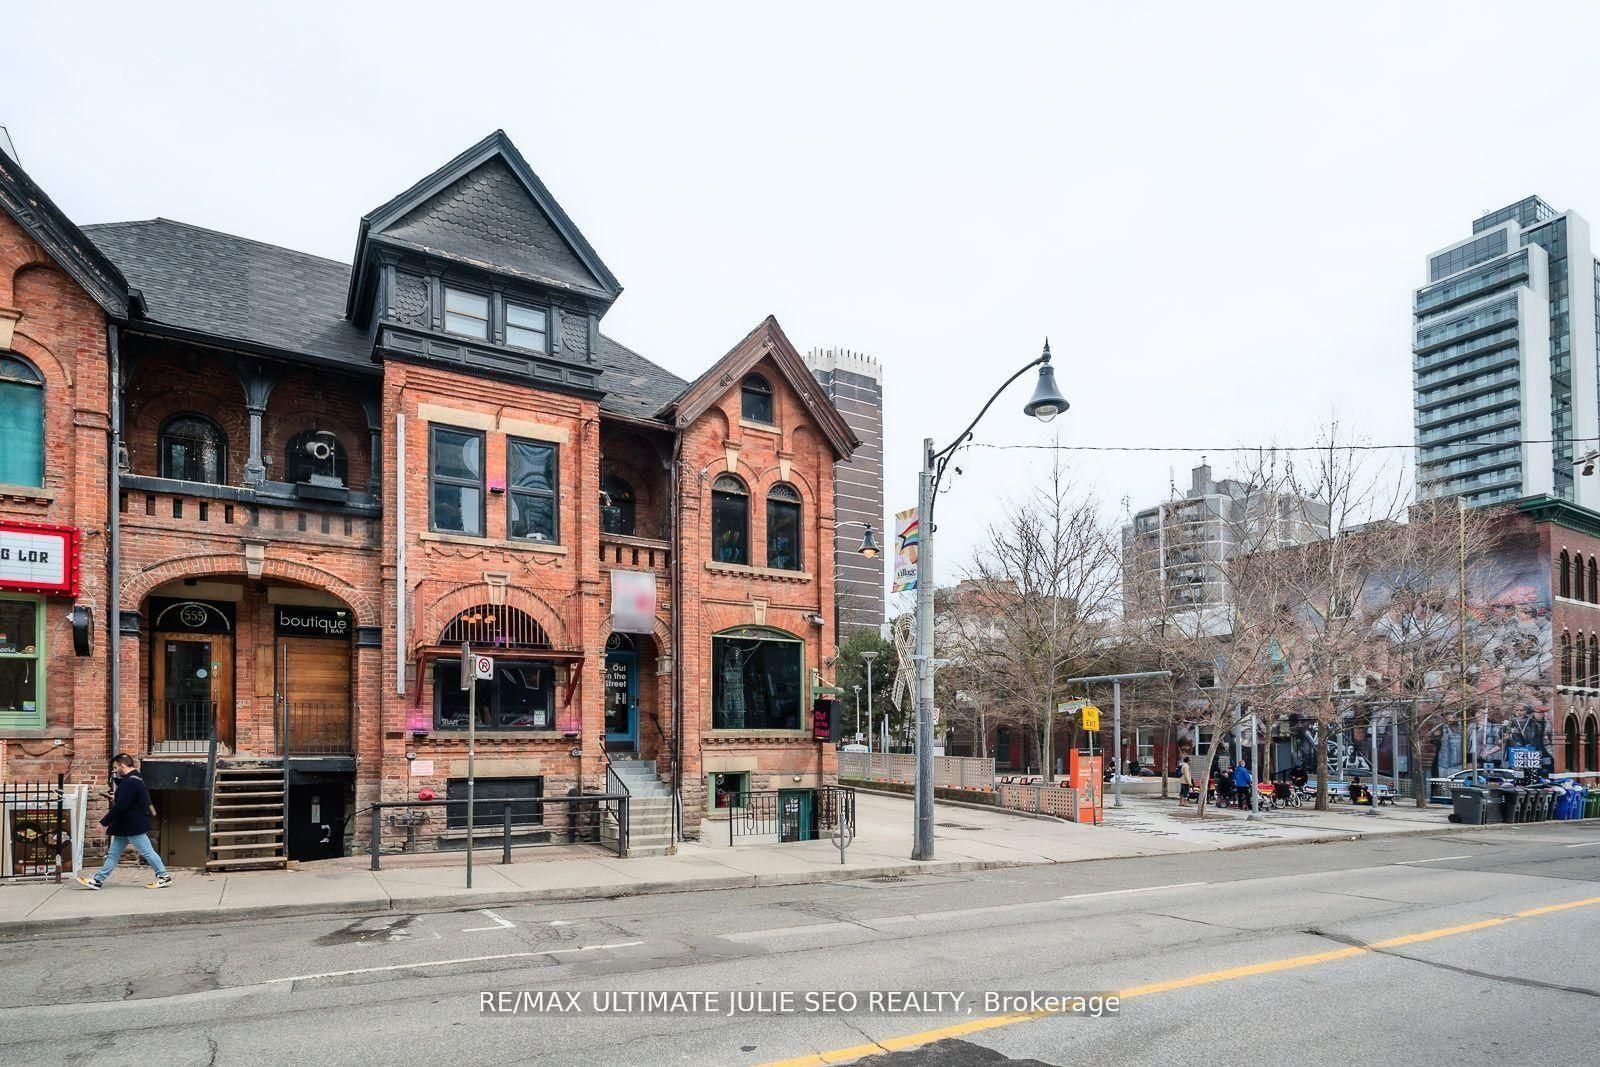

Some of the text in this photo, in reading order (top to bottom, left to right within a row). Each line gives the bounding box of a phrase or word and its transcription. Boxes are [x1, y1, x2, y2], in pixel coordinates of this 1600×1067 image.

[19, 549, 48, 563] LOR
[184, 610, 204, 621] 555
[280, 610, 347, 634] boutique
[612, 664, 626, 672] Out
[614, 672, 626, 680] the
[815, 711, 826, 720] Out
